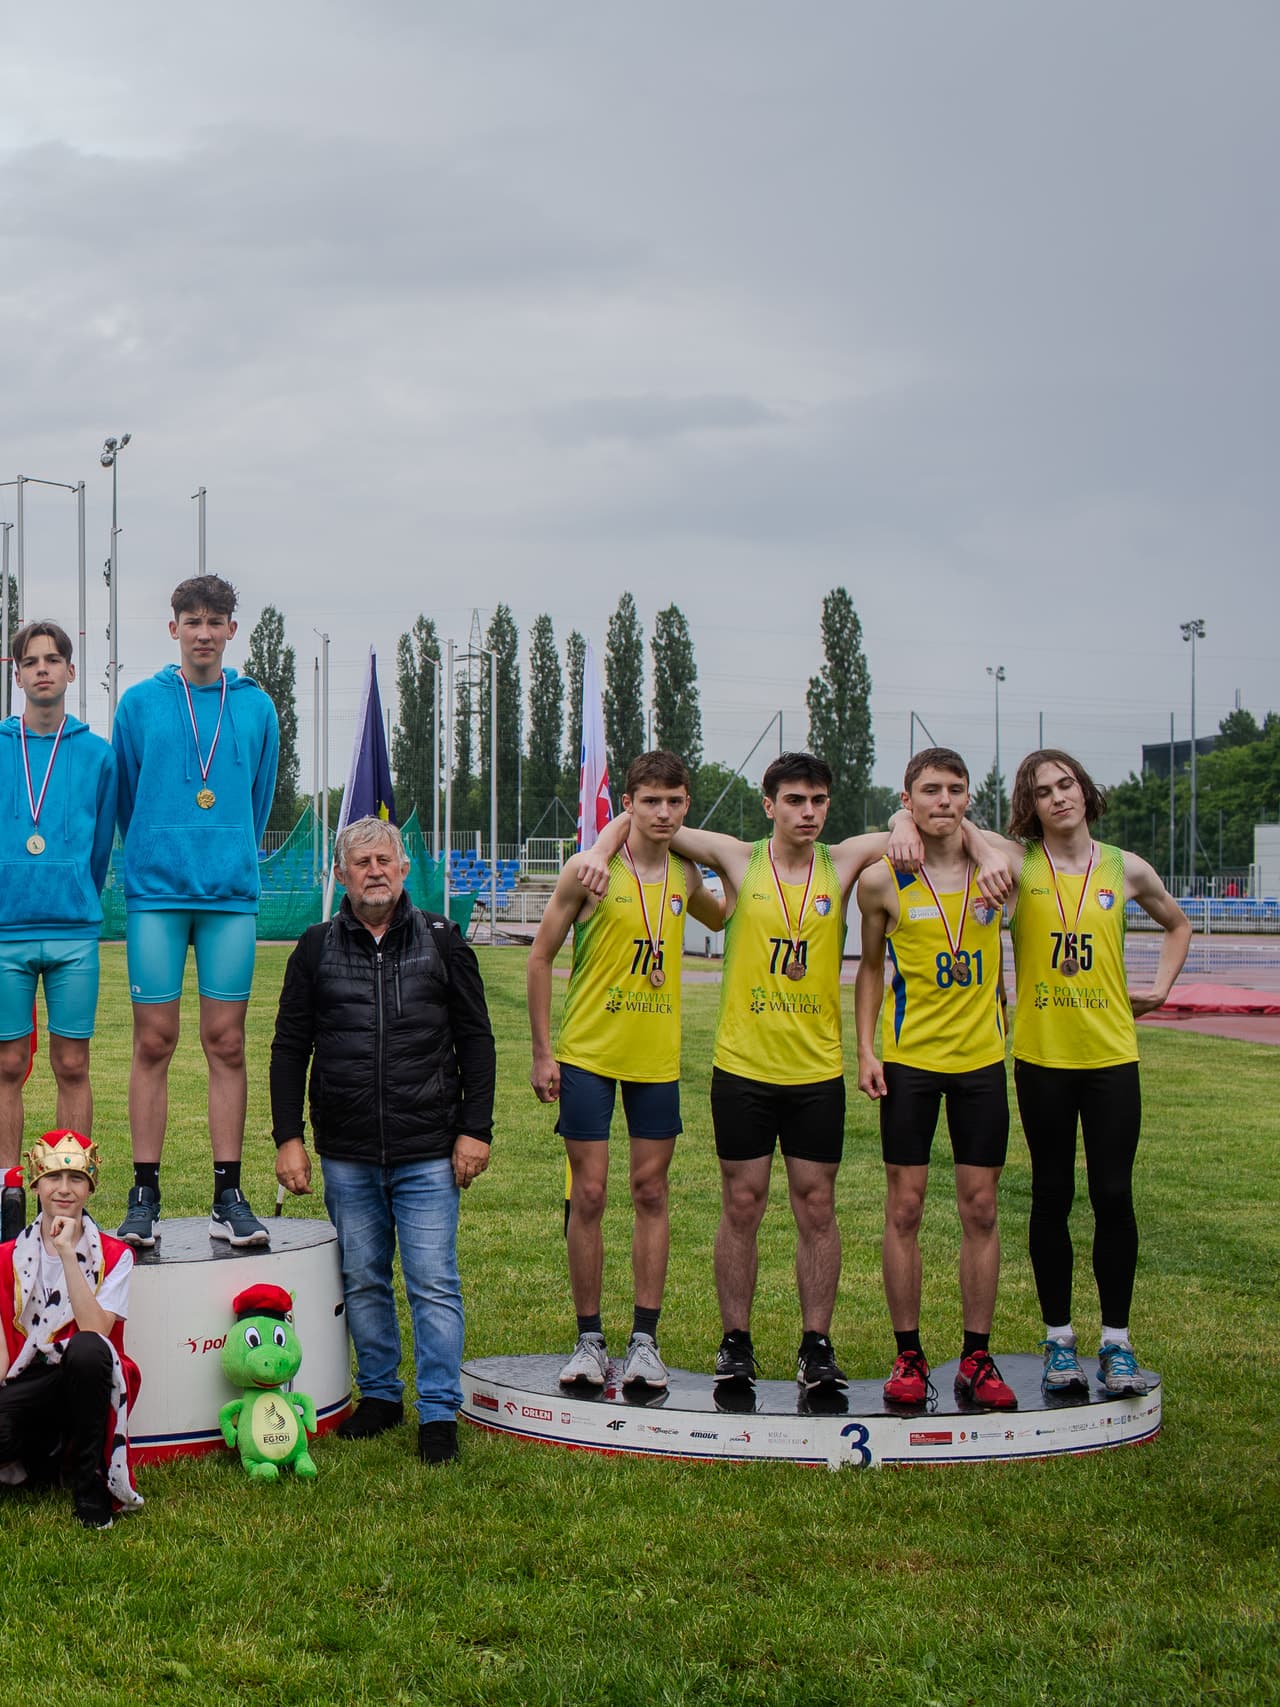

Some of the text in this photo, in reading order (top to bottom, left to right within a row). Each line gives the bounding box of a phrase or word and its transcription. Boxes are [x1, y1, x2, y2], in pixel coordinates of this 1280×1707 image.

[630, 939, 665, 975] 775
[1050, 932, 1093, 971] 765
[627, 991, 672, 1003] POWIAT
[1054, 986, 1105, 998] POWIAT
[1053, 997, 1109, 1009] WIELICKI
[523, 1409, 552, 1420] ORLEN
[606, 1420, 627, 1431] 4F
[840, 1423, 873, 1469] 3
